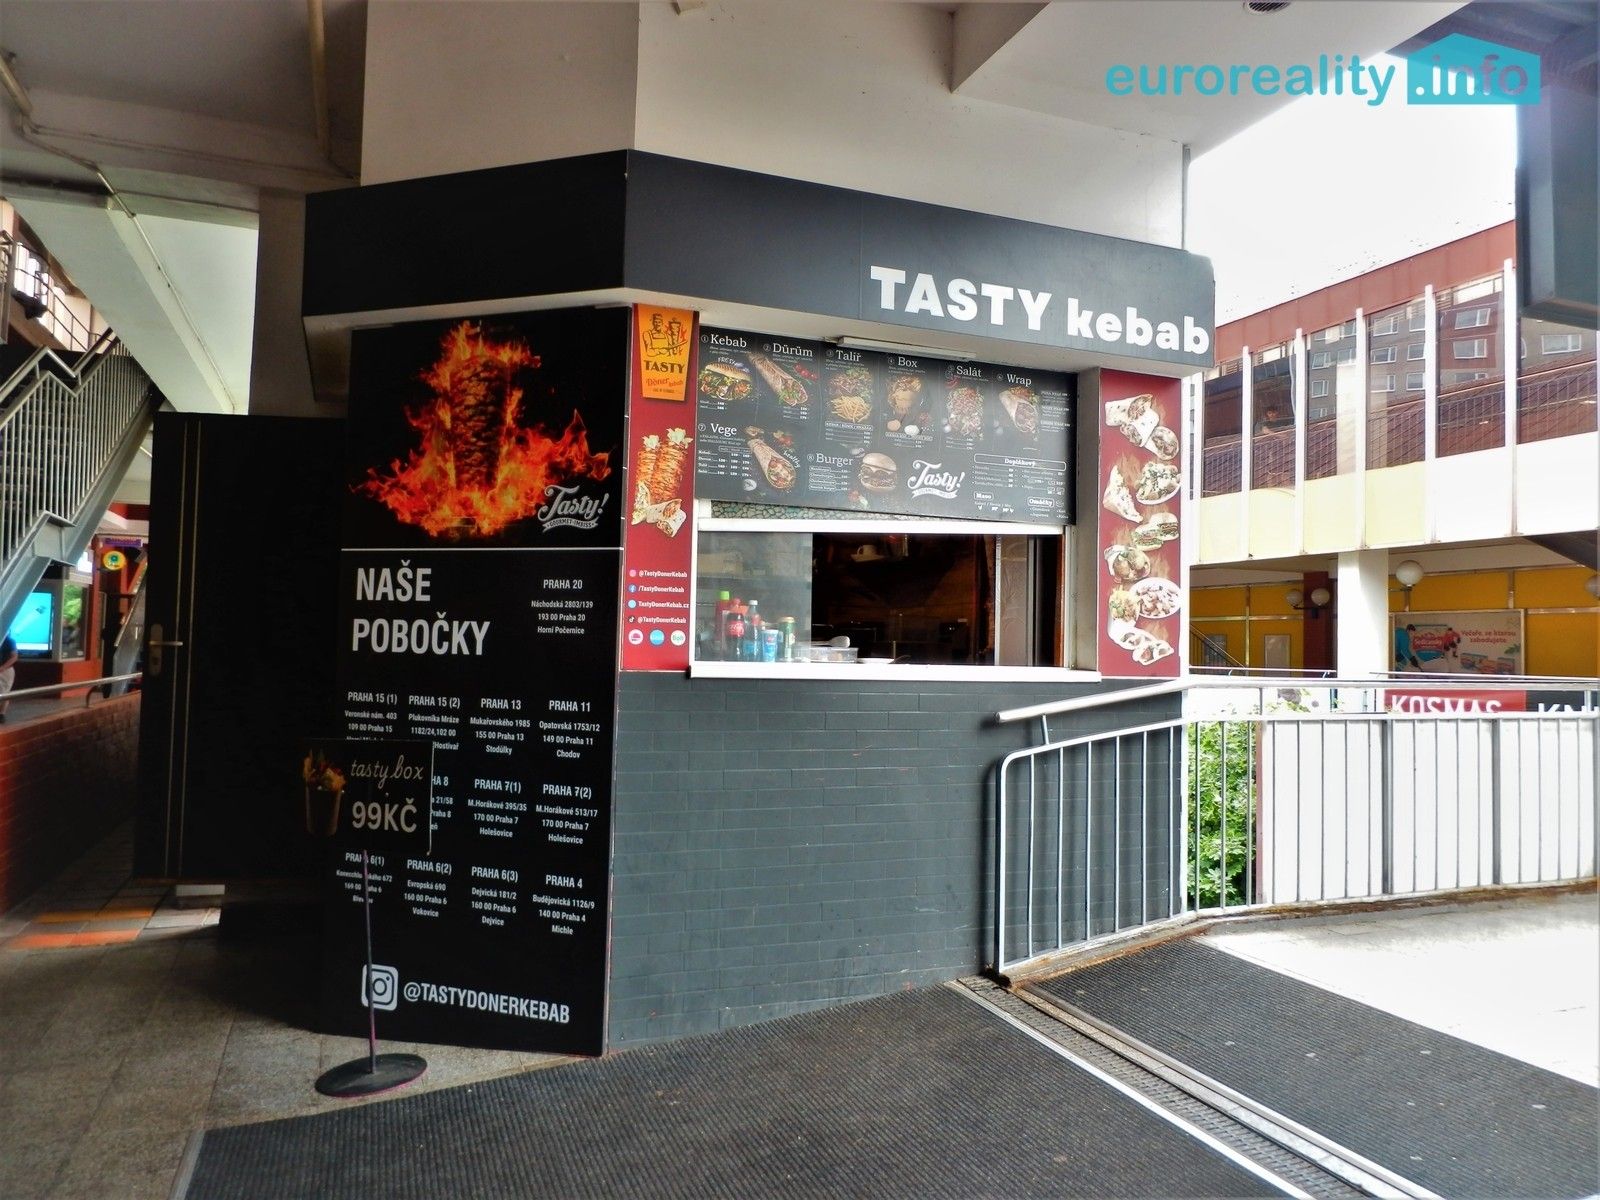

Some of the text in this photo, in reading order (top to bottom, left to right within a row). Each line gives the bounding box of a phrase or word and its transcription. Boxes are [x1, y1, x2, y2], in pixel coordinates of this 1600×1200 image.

[870, 265, 1210, 354] TASTY kebab
[710, 334, 747, 348] Kebab
[773, 343, 813, 357] Dürüm
[644, 360, 685, 374] TASTY
[898, 357, 918, 368] Box
[956, 365, 982, 377] Salát
[1006, 374, 1032, 387] Wrap
[710, 423, 737, 437] Vege
[816, 452, 853, 467] Burger
[908, 460, 965, 491] Tasty!
[538, 485, 610, 522] Tasty!
[639, 570, 687, 578] @TastyDonerKebab
[356, 559, 432, 602] NAŠE
[543, 579, 583, 589] PRAHA 20
[559, 613, 576, 621] Praha
[638, 616, 687, 624] @TastyDonerKebab
[352, 611, 491, 656] POBOČKY
[555, 626, 585, 634] Počernice
[347, 692, 398, 705] PRAHA 15 (1)
[408, 695, 460, 709] PRAHA 15 (2)
[481, 698, 522, 710] PRAHA 13
[549, 700, 591, 712] PRAHA 11
[386, 712, 397, 720] 403
[368, 724, 384, 732] Praha
[385, 725, 392, 733] 15
[470, 717, 531, 728] Mukařovského 1985
[539, 721, 600, 732] Opatovská 1753/12
[475, 731, 524, 741] 155 00 Praha 13
[543, 735, 554, 743] 149
[565, 736, 584, 745] Praha
[586, 737, 593, 745] 11
[556, 749, 580, 758] Chodov
[351, 755, 424, 789] tasty box
[474, 778, 521, 794] PRAHA 7(1)
[543, 783, 592, 800] PRAHA 7(2)
[467, 799, 527, 812] M.Horákové 395/35
[536, 805, 598, 818] M.Horákové 513/17
[352, 797, 417, 833] 99KČ
[474, 813, 485, 821] 170
[486, 814, 494, 822] 00
[495, 815, 513, 824] Praha
[542, 819, 589, 831] 170 00 Praha 7
[479, 826, 513, 838] Holešovice
[548, 833, 584, 844] Holešovice
[370, 855, 385, 867] 6(1)
[407, 860, 452, 875] PRAHA 6(2)
[471, 866, 519, 883] PRAHA 6(3)
[407, 880, 446, 891] Evropská 690
[545, 875, 583, 888] PRAHA 4
[404, 893, 415, 901] 160
[425, 895, 442, 904] Praha
[472, 887, 517, 899] Dejvická 181/2
[471, 901, 482, 909] 160
[493, 903, 511, 913] Praha
[532, 894, 595, 909] Budějovická 1126/9
[412, 907, 439, 917] Vokovice
[539, 909, 550, 918] 140
[552, 911, 560, 919] 00
[562, 912, 580, 922] Praha
[481, 916, 504, 926] Dejvice
[551, 925, 574, 935] Michle
[403, 981, 570, 1024] @TASTYDONERKEBAB
